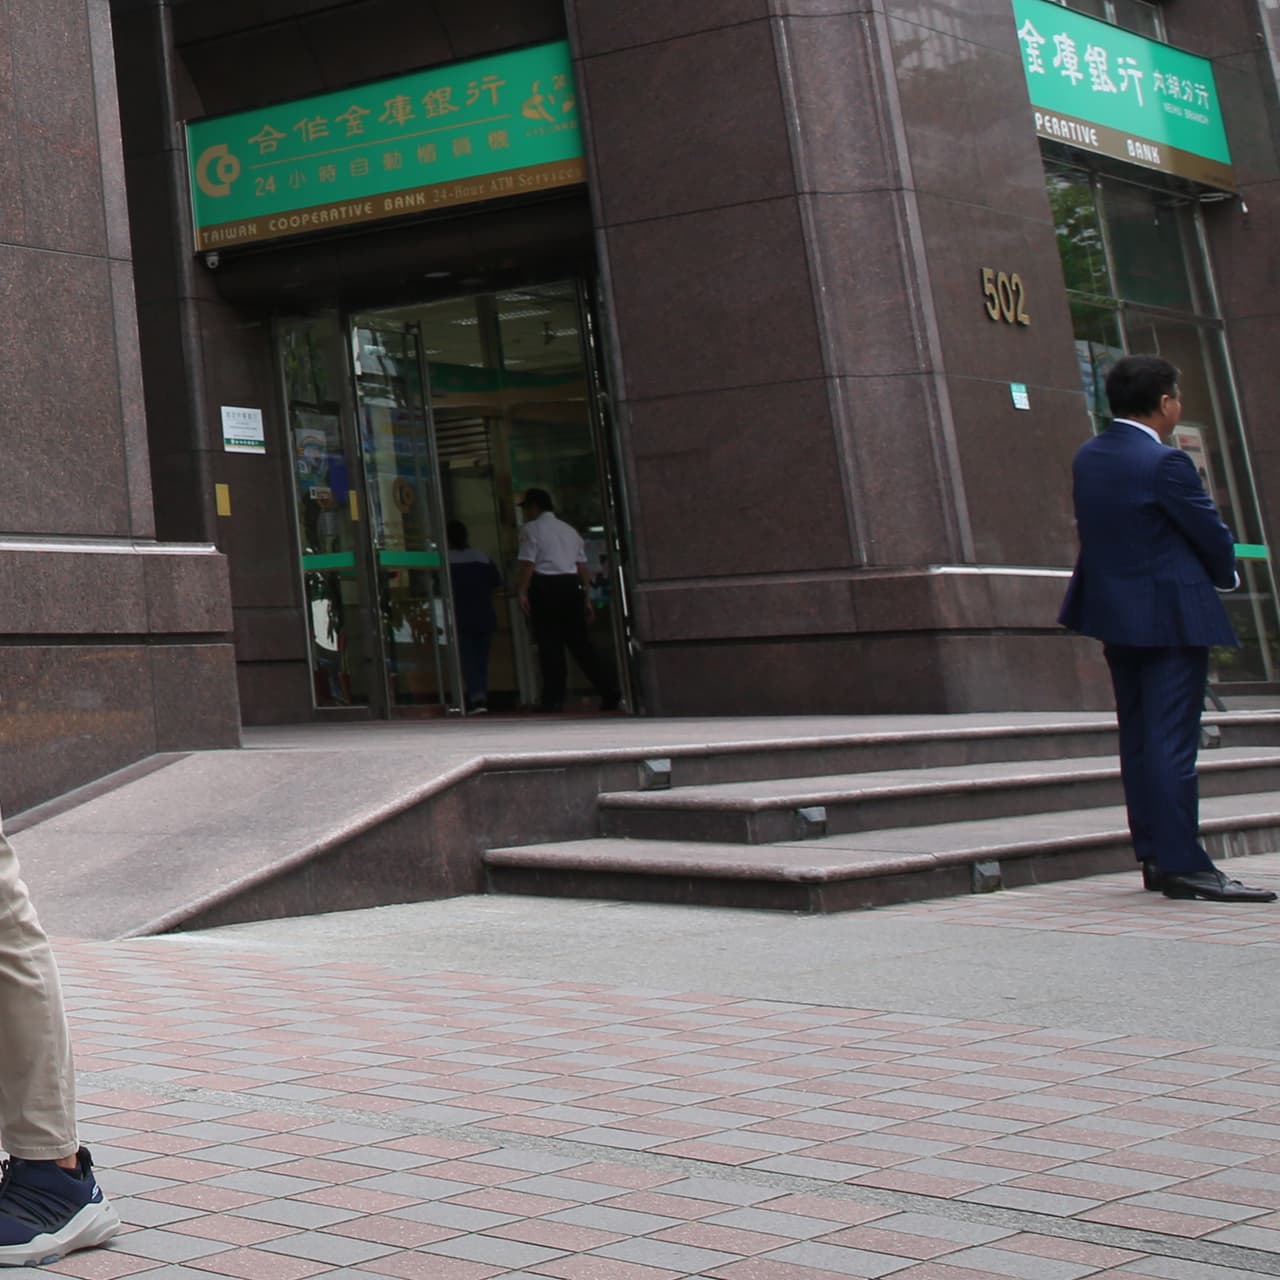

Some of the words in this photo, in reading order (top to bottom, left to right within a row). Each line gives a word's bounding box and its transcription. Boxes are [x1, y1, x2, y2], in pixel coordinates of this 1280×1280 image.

[247, 74, 507, 155] 合作金庫銀行
[1035, 111, 1099, 147] PERATIVE
[1127, 138, 1160, 164] BANK
[203, 223, 258, 245] TAIWAN
[269, 201, 373, 232] COOPERATIVE
[384, 192, 426, 211] BANK
[982, 266, 1031, 326] 502
